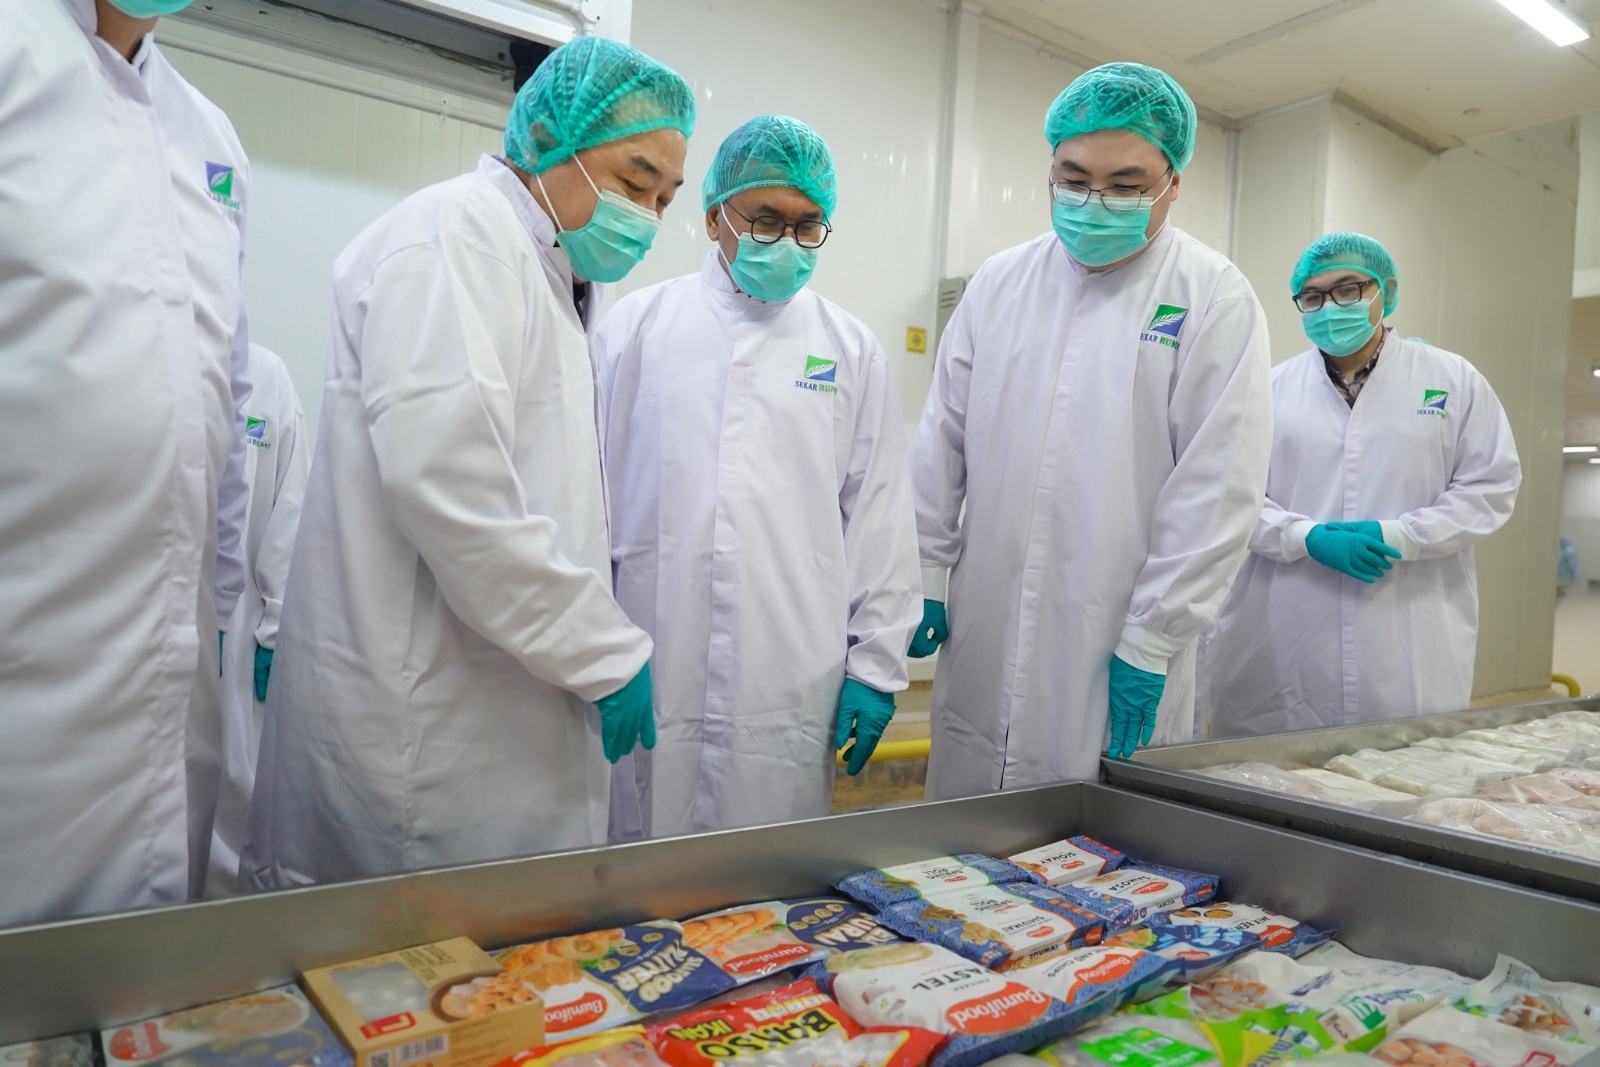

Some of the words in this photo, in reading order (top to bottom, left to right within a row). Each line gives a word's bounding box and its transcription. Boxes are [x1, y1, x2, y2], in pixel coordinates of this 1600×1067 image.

[1140, 332, 1158, 343] EKAR
[795, 380, 818, 391] SEKAR
[818, 384, 838, 395] BUM
[252, 438, 271, 449] BUMI
[1040, 851, 1077, 866] SIOMAY
[1109, 875, 1150, 892] SAMOSA
[1230, 921, 1253, 932] BEN
[1253, 915, 1270, 926] MIX
[611, 938, 689, 992] PLATTER
[726, 945, 808, 972] Bumifood
[1075, 951, 1093, 961] AND
[1047, 959, 1075, 978] CHIPS
[1078, 955, 1132, 982] Bumifood
[911, 966, 991, 993] ASTEL
[544, 996, 603, 1023] Bumifoo
[950, 987, 1046, 1029] Bumifood
[668, 1018, 733, 1041] IKAN
[701, 1010, 836, 1057] BAKSO
